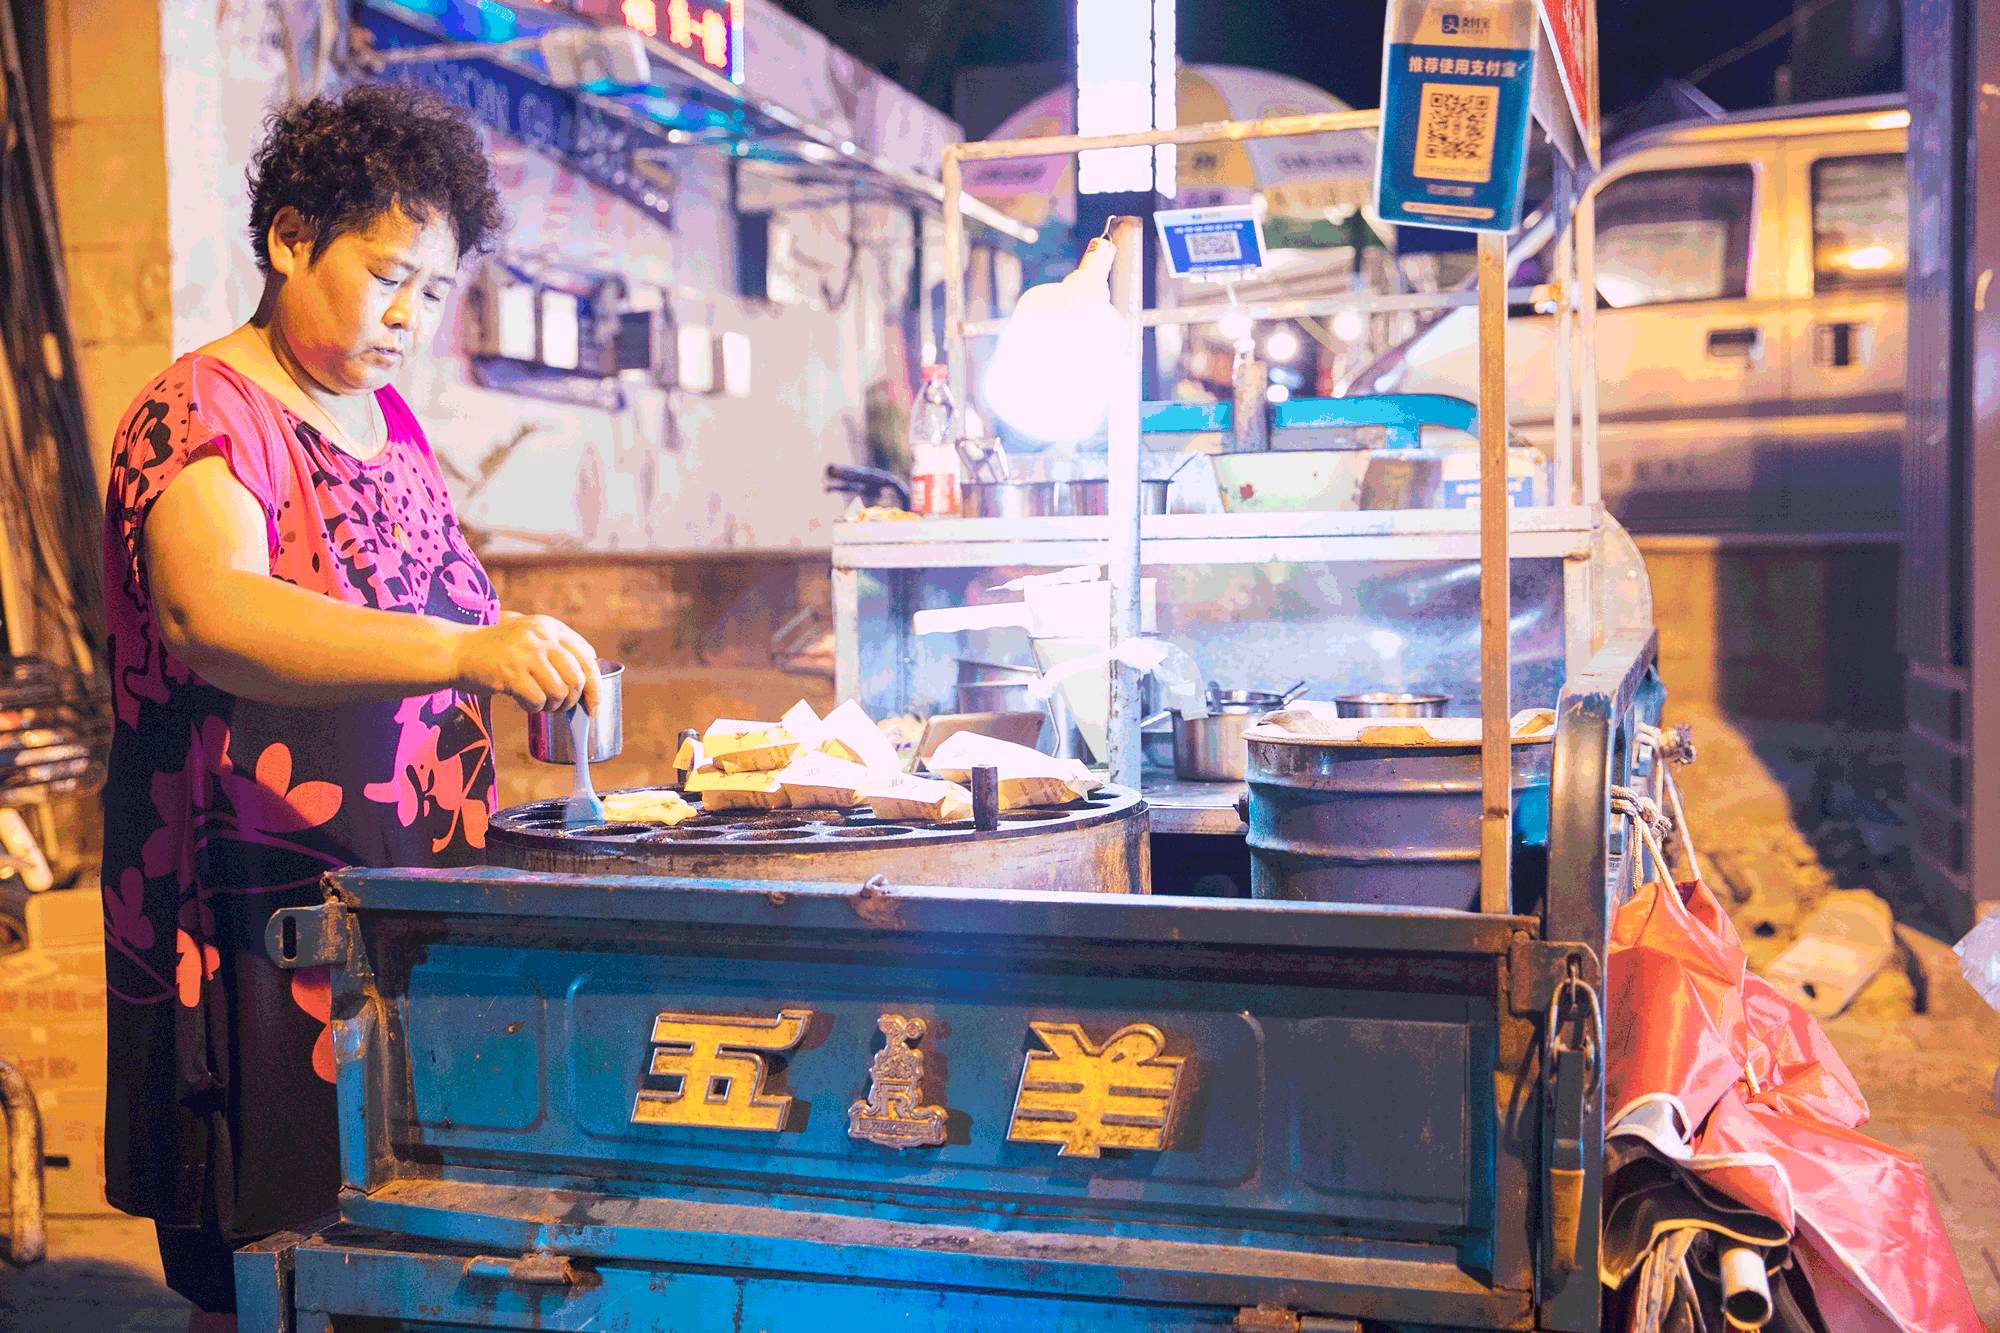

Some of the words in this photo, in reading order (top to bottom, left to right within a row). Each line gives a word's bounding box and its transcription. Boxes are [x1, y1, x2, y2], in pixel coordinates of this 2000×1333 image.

[1408, 56, 1517, 77] 推荐使用支付宝
[631, 1009, 813, 1131] 五
[1007, 1022, 1187, 1159] 羊
